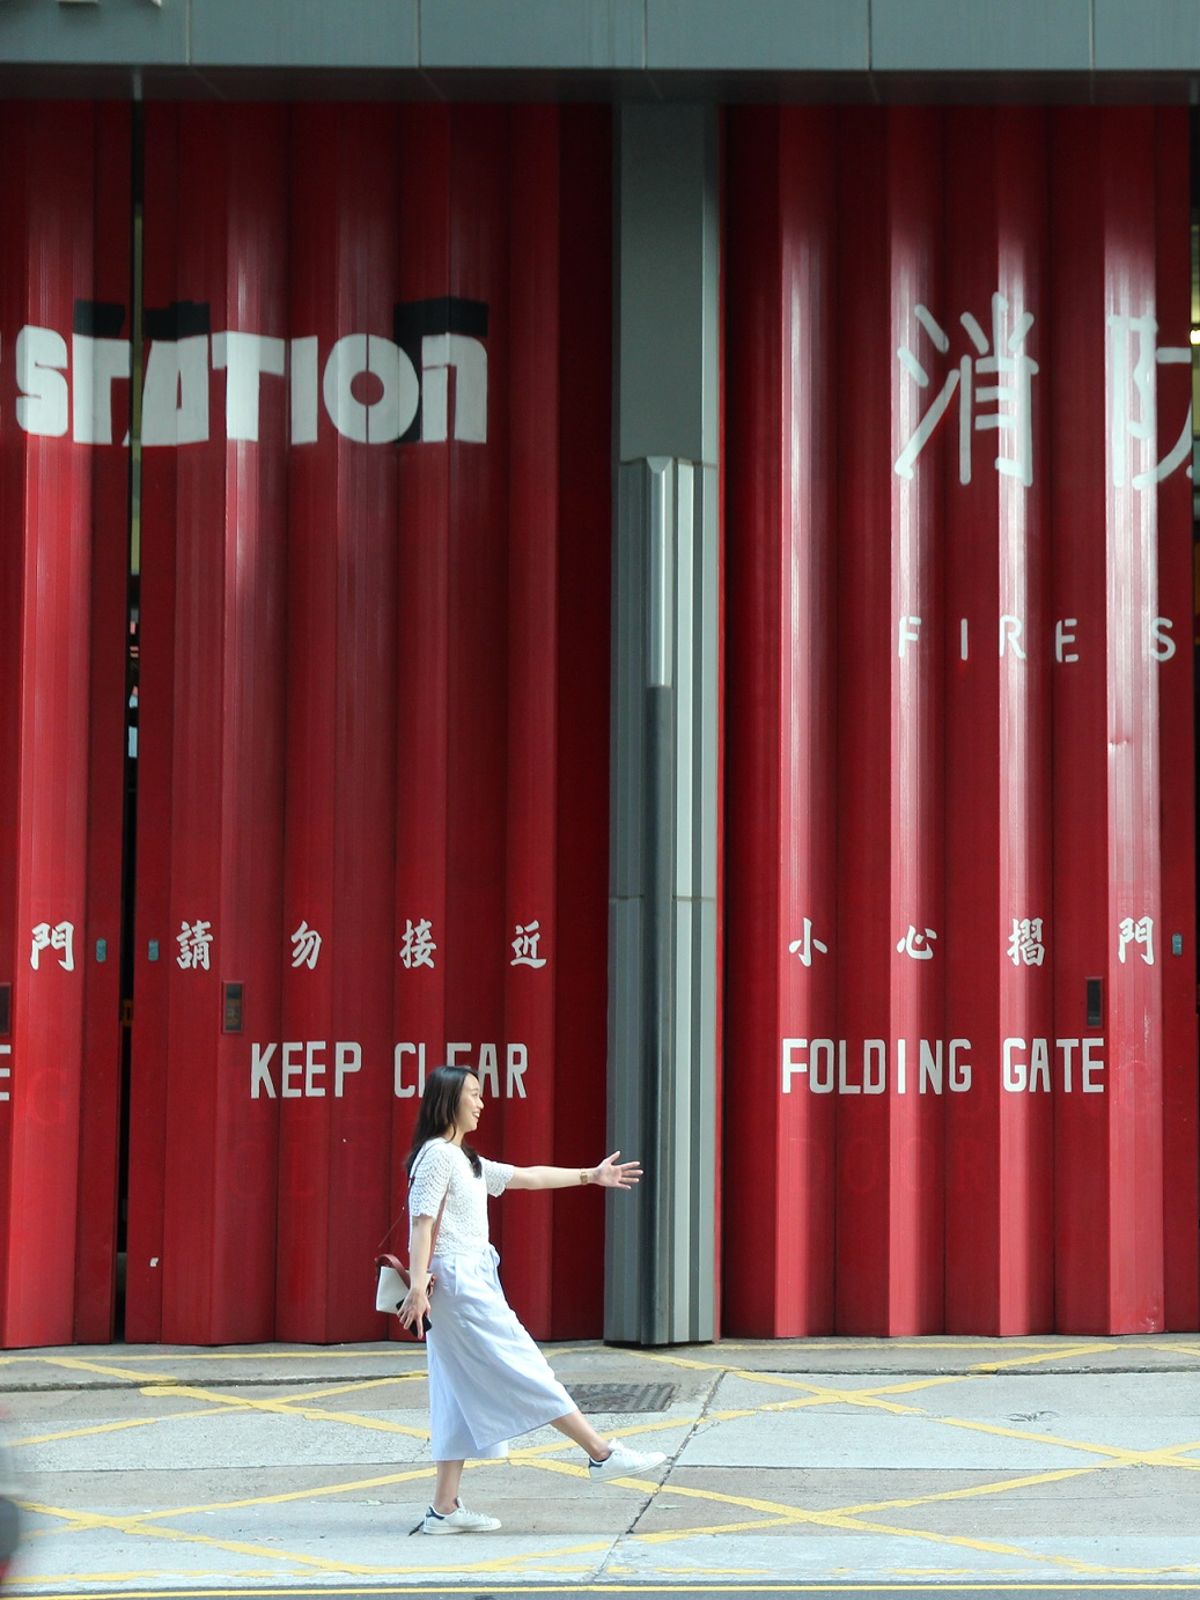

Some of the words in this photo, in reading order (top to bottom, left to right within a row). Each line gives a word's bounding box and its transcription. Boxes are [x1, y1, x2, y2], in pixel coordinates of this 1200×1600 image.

[898, 613, 1079, 662] FIRE
[30, 920, 76, 971] 門
[175, 918, 548, 971] 請勿接近
[788, 915, 1155, 967] 小心摺門
[250, 1041, 362, 1100] KEEP
[781, 1038, 972, 1095] FOLDING
[1002, 1037, 1105, 1093] GATE
